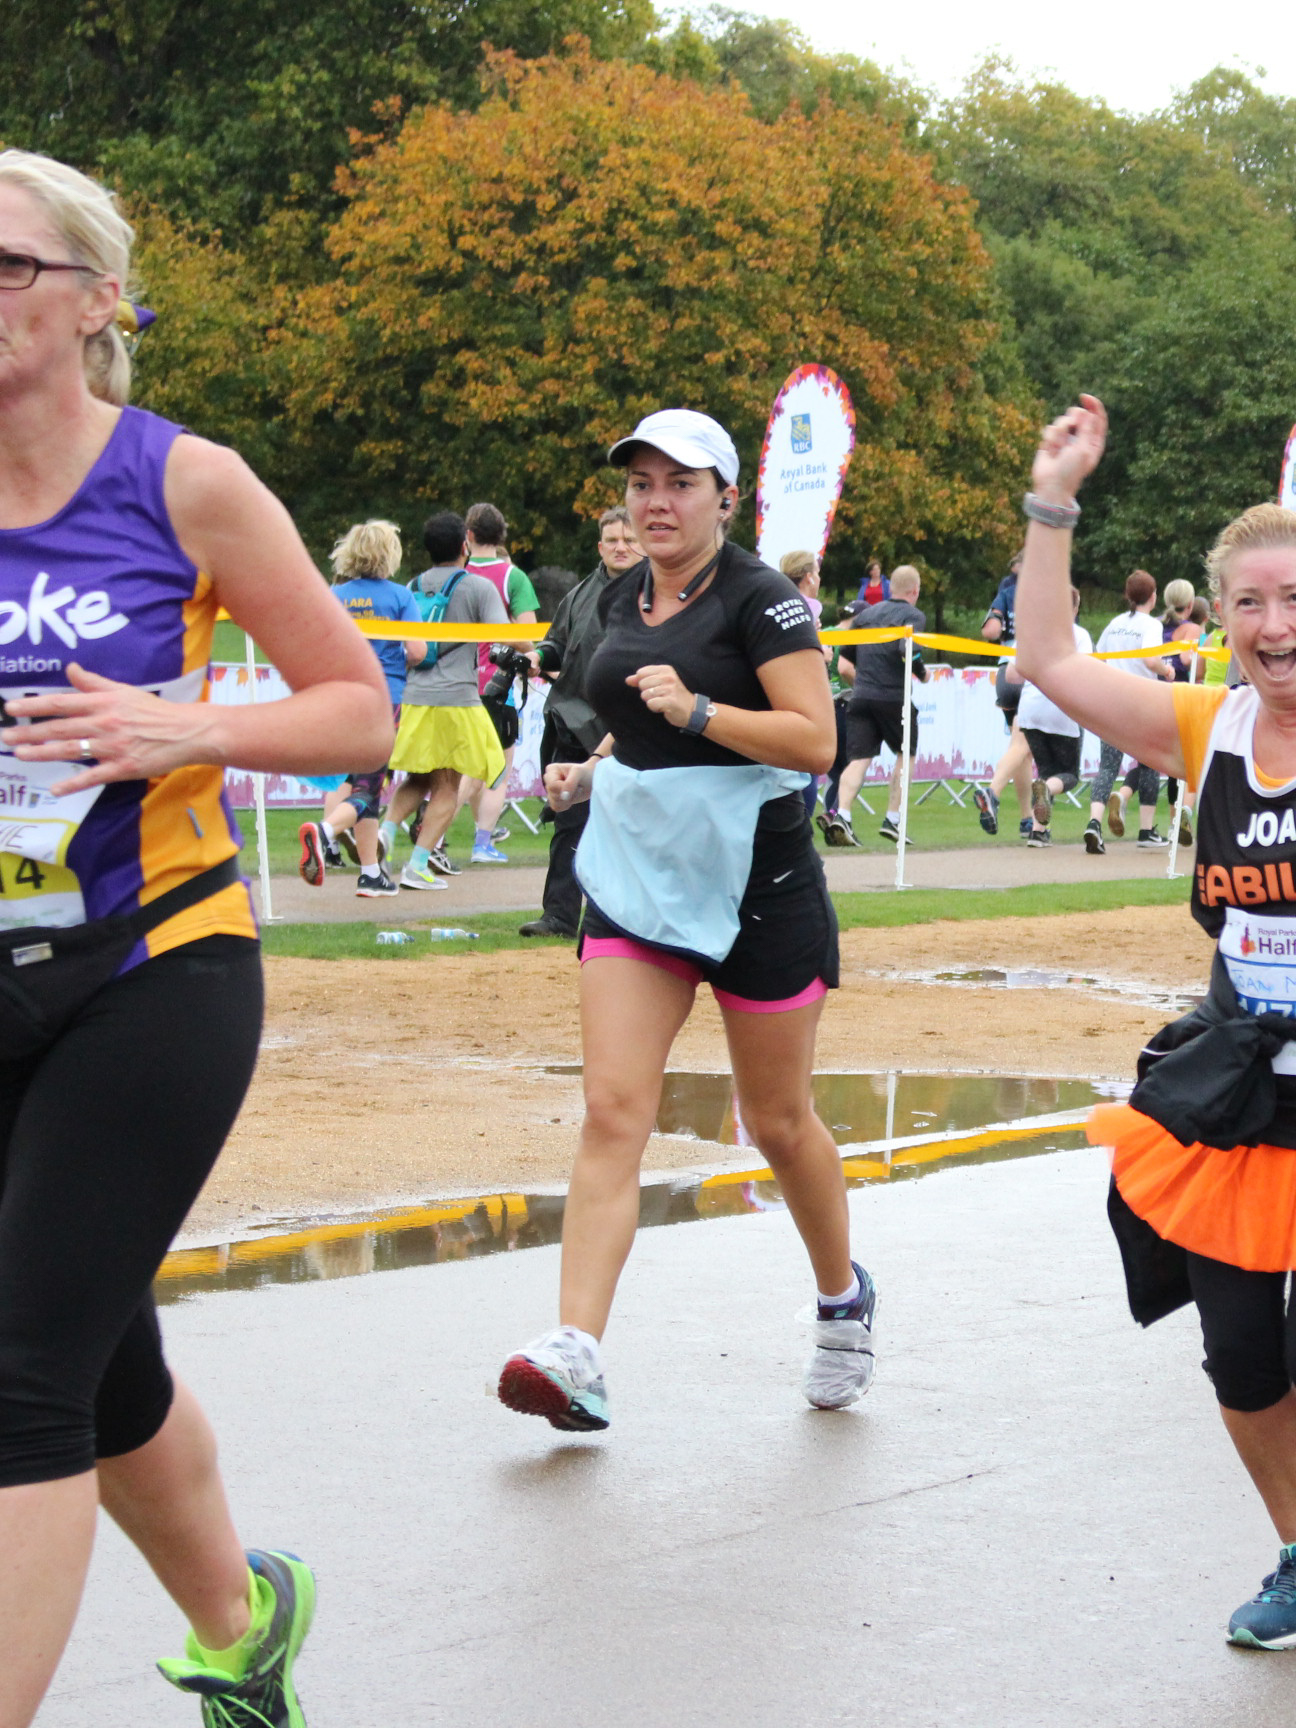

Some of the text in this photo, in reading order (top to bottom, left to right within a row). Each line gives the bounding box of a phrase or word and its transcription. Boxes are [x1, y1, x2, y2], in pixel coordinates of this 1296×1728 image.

[794, 442, 812, 452] RBC
[781, 463, 827, 480] Royal Bank
[784, 478, 825, 493] of Canada
[775, 599, 804, 612] ROYAL
[774, 606, 805, 623] PARKS
[1258, 928, 1278, 937] Royal
